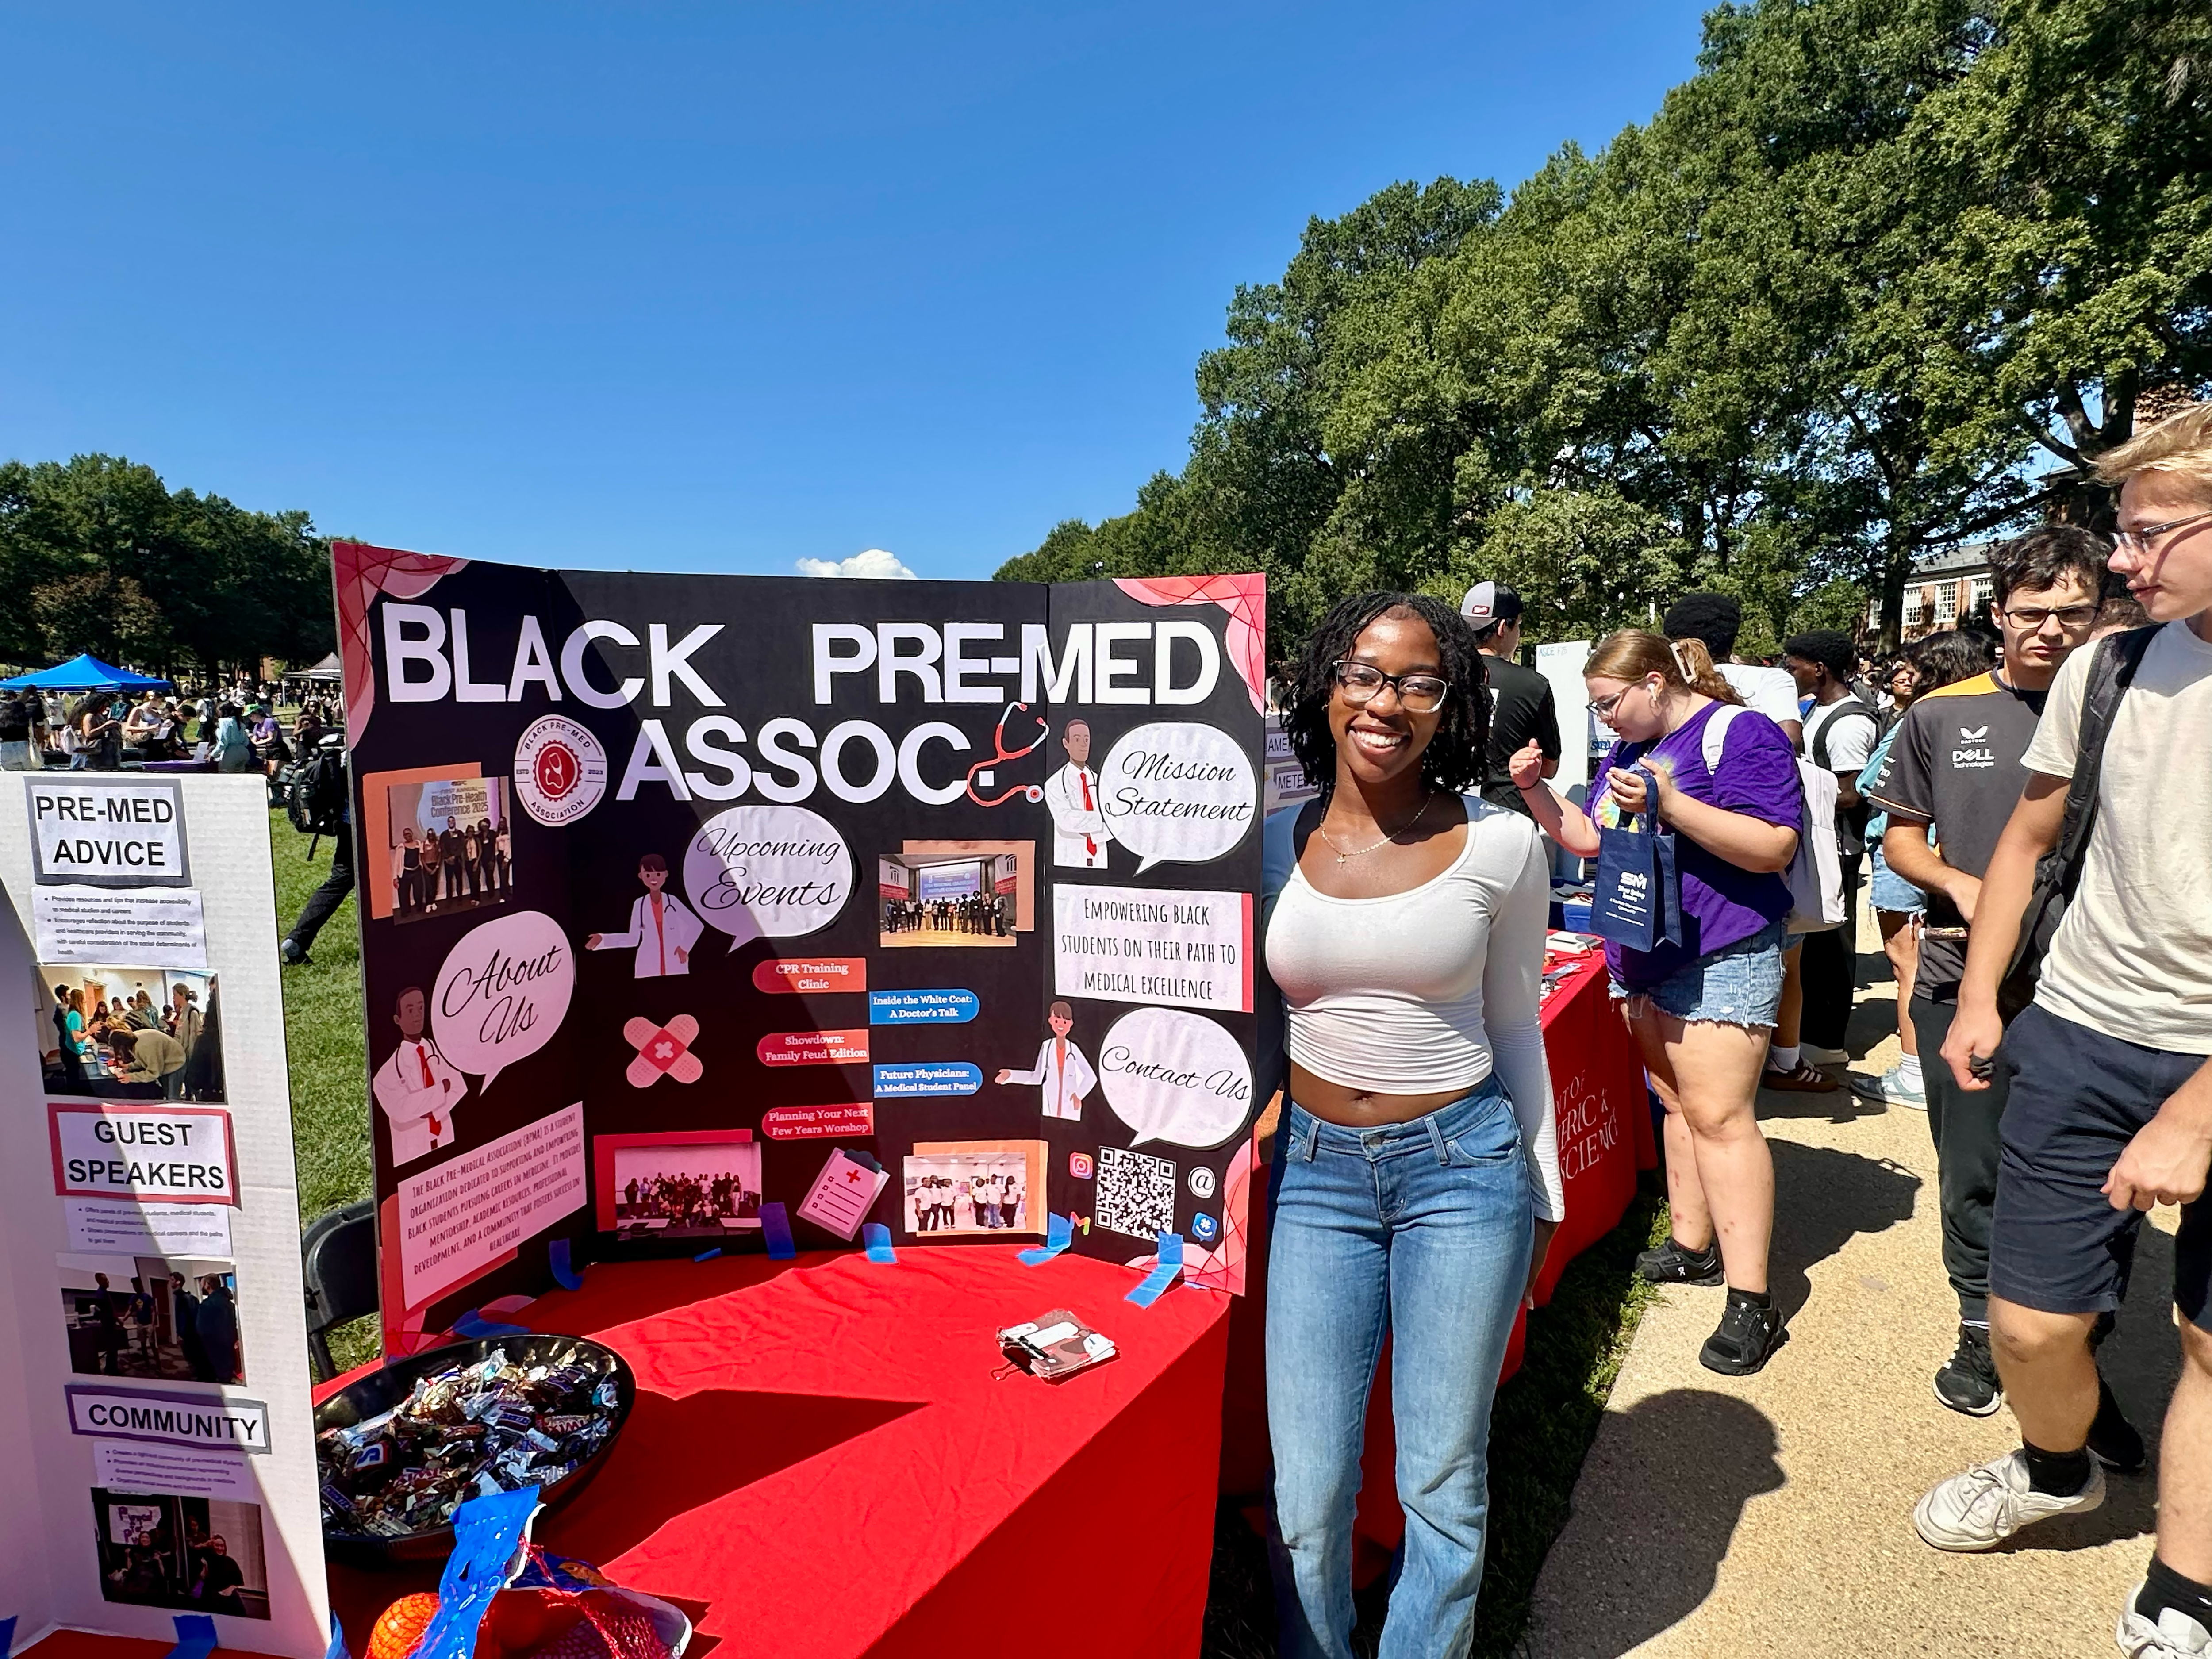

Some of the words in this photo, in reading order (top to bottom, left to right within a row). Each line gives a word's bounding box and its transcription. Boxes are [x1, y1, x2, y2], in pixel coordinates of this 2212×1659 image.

[383, 603, 726, 709] BLACK
[812, 620, 1220, 705] PRE-MED
[525, 724, 547, 749] BLACK
[550, 722, 591, 748] PRE-MED
[616, 715, 994, 805] ASSOC.
[1122, 751, 1236, 780] Mission
[1953, 749, 1995, 762] DELL
[1278, 774, 1304, 789] METE
[36, 796, 173, 823] PRE-MED
[431, 795, 452, 806] Black
[431, 805, 471, 818] Conference
[472, 801, 488, 813] 2025
[531, 799, 585, 819] ASSOCIATION
[1105, 787, 1253, 821] Statement
[53, 839, 165, 866] ADVICE
[697, 827, 840, 864] Upcoming
[700, 867, 841, 910] Events
[1084, 899, 1167, 923] EMPOWERING
[1174, 904, 1209, 926] BLACK
[1062, 935, 1118, 956] STUDENTS
[1124, 939, 1141, 957] ON
[1147, 940, 1181, 961] THEIR
[1187, 942, 1214, 963] PATH
[1220, 944, 1235, 964] TO
[442, 945, 563, 1017] About
[776, 964, 800, 974] CPR
[802, 964, 849, 975] Training
[798, 979, 830, 989] Clinic
[1084, 972, 1136, 994] MEDICAL
[1142, 976, 1213, 1000] EXCELLENCE
[873, 996, 902, 1005] Inside
[903, 995, 918, 1004] the
[920, 995, 947, 1004] White
[949, 995, 972, 1004] Coat:
[890, 1010, 898, 1018] A
[899, 1009, 937, 1018] Doctor's
[938, 1008, 959, 1017] Talk
[479, 996, 538, 1044] Us
[785, 1036, 845, 1045] Showdown:
[765, 1050, 800, 1062] Family
[803, 1050, 827, 1059] Feud
[830, 1048, 867, 1058] Edition
[880, 1071, 914, 1080] Future
[915, 1069, 969, 1080] Physicians:
[1102, 1046, 1201, 1088] Contact
[1204, 1070, 1249, 1100] Us
[876, 1084, 883, 1093] A
[884, 1083, 917, 1092] Medical
[918, 1083, 952, 1091] Student
[953, 1082, 976, 1091] Panel
[1556, 1086, 1569, 1115] NT
[769, 1110, 815, 1122] Planning
[816, 1109, 842, 1119] Your
[844, 1108, 868, 1118] Next
[94, 1121, 192, 1146] GUEST
[772, 1126, 795, 1137] Few
[796, 1125, 822, 1135] Years
[823, 1124, 868, 1134] Worshop
[412, 1184, 423, 1198] THE
[426, 1175, 444, 1192] BLACK
[446, 1156, 485, 1182] PRE-MEDICAL
[487, 1138, 522, 1163] ASSOCIATION
[543, 1125, 549, 1135] IS
[550, 1122, 554, 1132] A
[554, 1112, 575, 1129] STUDENT
[69, 1160, 224, 1189] SPEAKERS
[410, 1187, 457, 1218] ORGANIZATION
[460, 1172, 490, 1194] DEDICATED
[490, 1167, 498, 1178] TO
[499, 1151, 532, 1175] SUPPORTING
[533, 1145, 544, 1157] AND
[408, 1221, 427, 1239] BLACK
[428, 1205, 459, 1229] STUDENTS
[461, 1190, 490, 1212] PURSUING
[491, 1178, 512, 1197] CAREERS
[513, 1174, 521, 1185] IN
[472, 1202, 501, 1224] ACADEMIC
[533, 1167, 567, 1192] PROFESSIONAL
[463, 1233, 476, 1248] AND
[478, 1230, 482, 1240] A
[483, 1210, 519, 1237] COMMUNITY
[520, 1202, 532, 1216] THAT
[489, 1226, 520, 1251] HEALTHCARE
[88, 1404, 257, 1440] COMMUNITY
